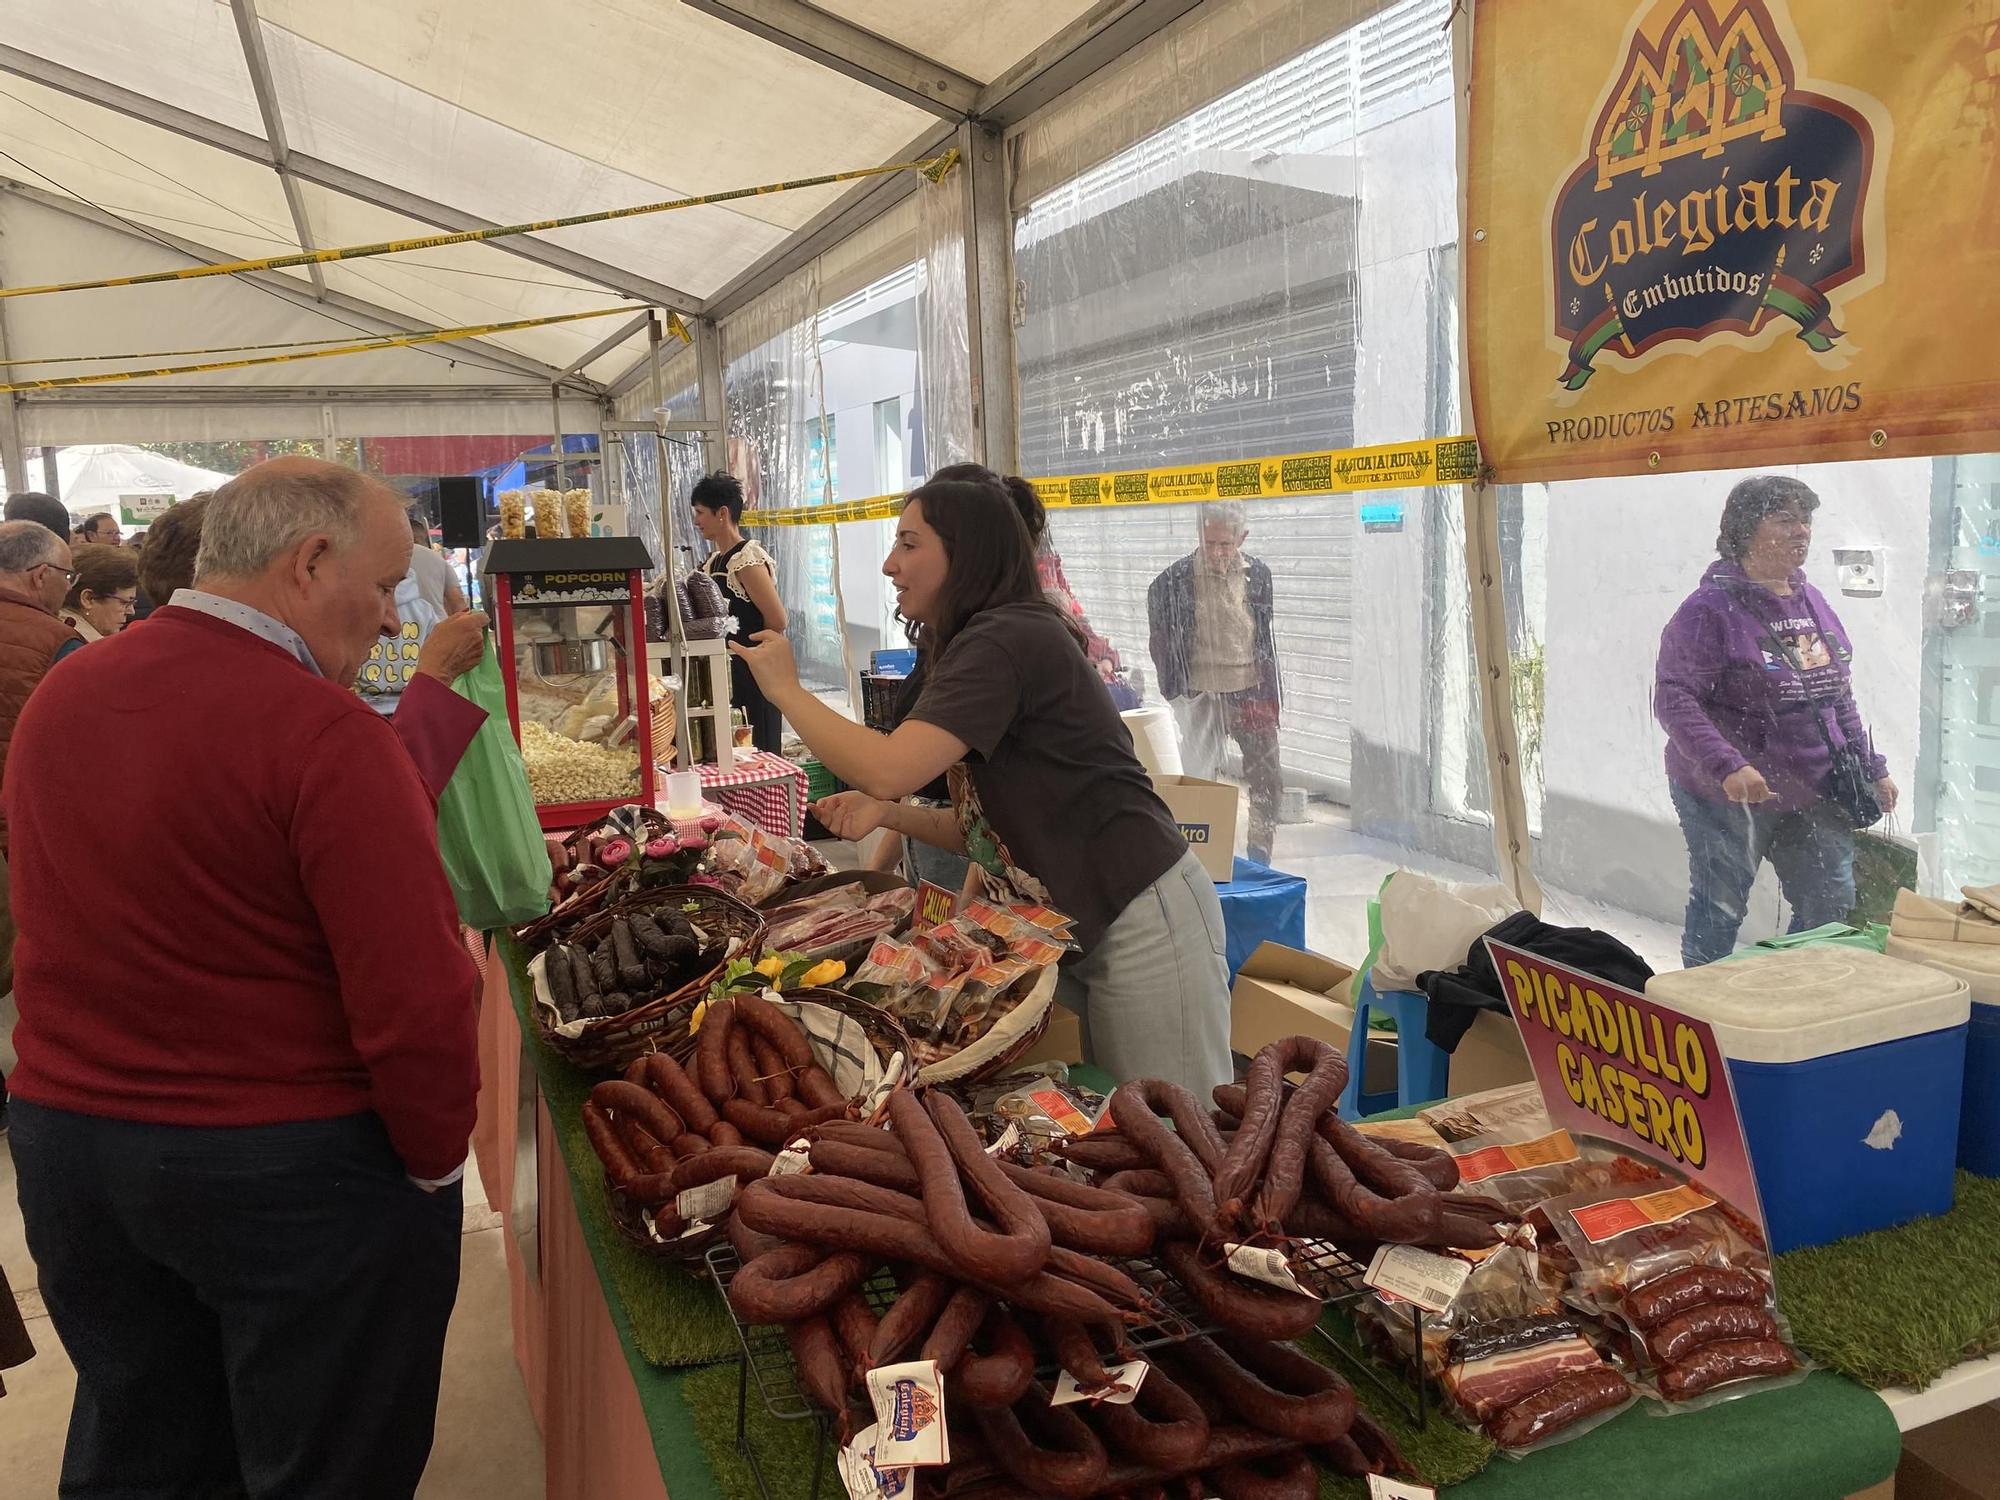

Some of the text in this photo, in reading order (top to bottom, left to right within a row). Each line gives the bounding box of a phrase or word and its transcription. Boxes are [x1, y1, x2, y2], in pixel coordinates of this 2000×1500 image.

[1568, 165, 1841, 287] Colegiata
[1622, 264, 1765, 319] Embutidos
[1547, 383, 1861, 443] PRODUCTOS ARTESANOS
[544, 572, 626, 584] POPCORN
[1181, 825, 1206, 842] kro
[1506, 959, 1712, 1099] PICADILLO
[1556, 1043, 1707, 1170] CASERO
